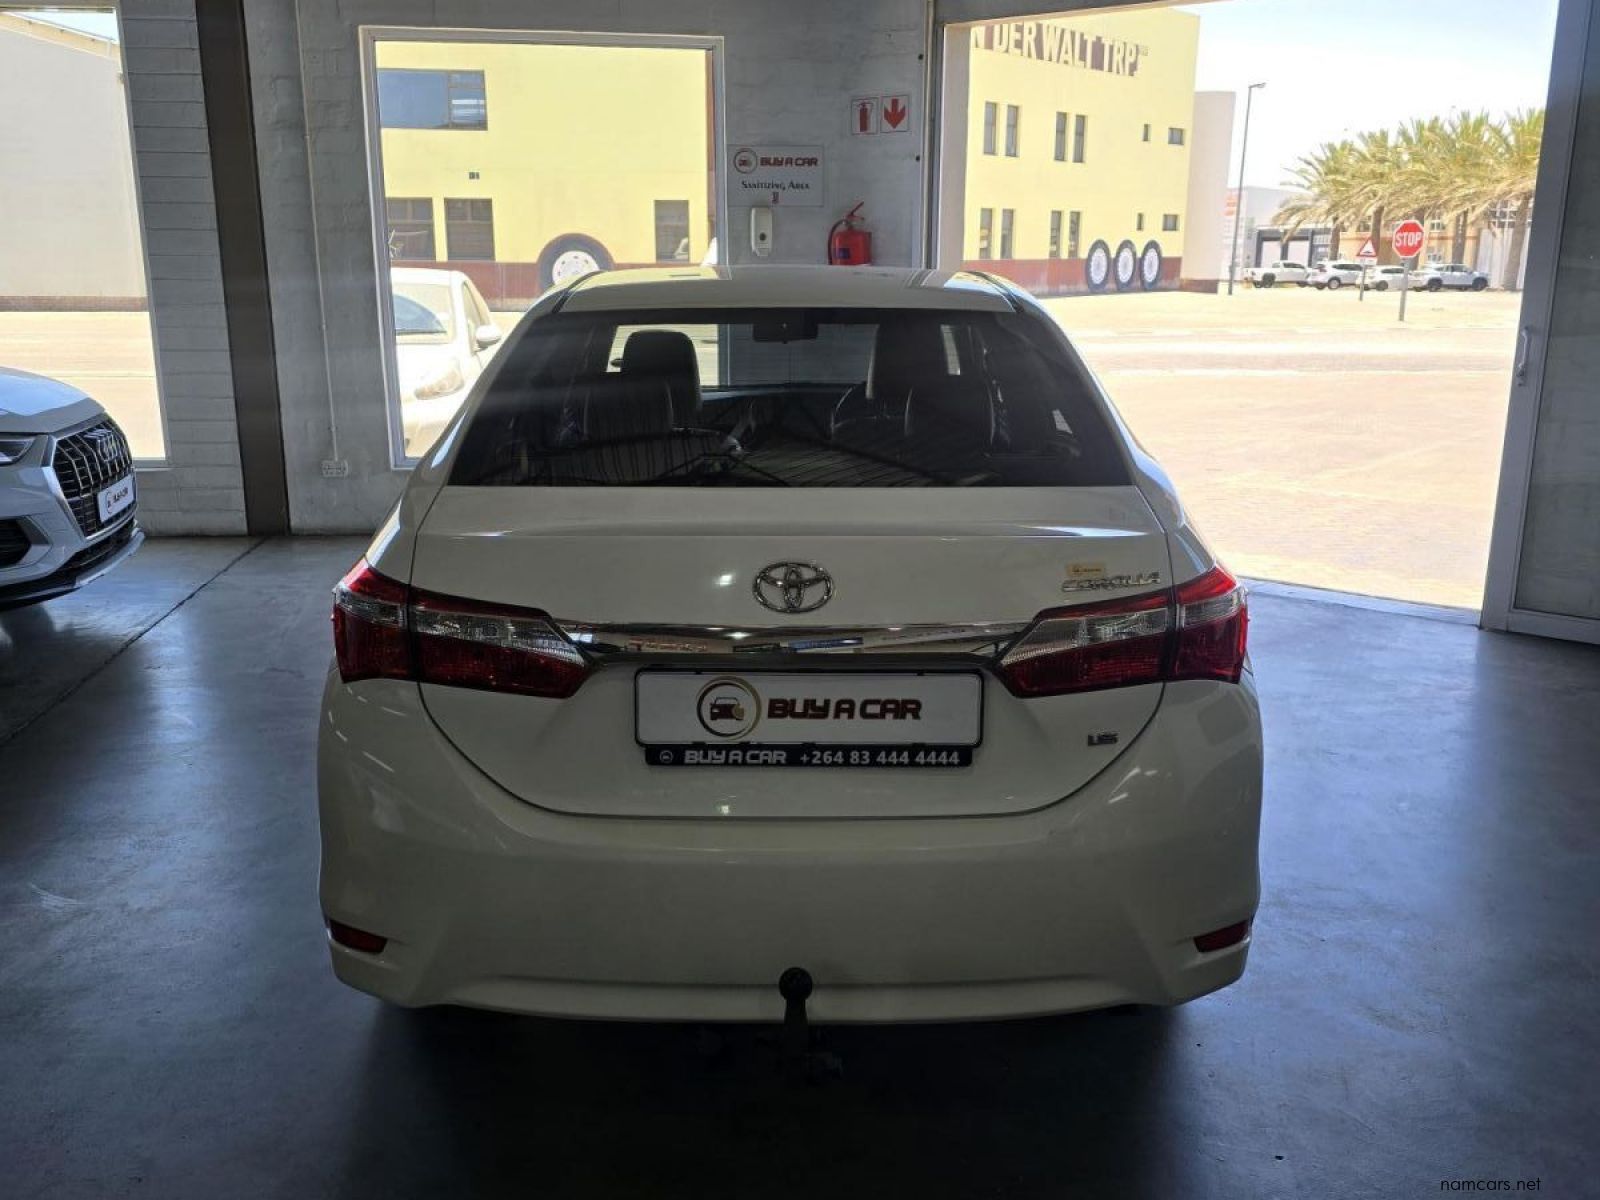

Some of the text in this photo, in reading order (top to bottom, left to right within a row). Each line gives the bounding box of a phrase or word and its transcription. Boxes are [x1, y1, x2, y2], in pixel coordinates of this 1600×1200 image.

[992, 22, 1037, 58] DER
[1042, 23, 1096, 69] WALT
[760, 156, 819, 167] BUY A CAR
[1395, 231, 1422, 247] STOP
[767, 697, 922, 720] BUY A CAR
[684, 750, 960, 764] BUY A CAR +264 83 444 4444
